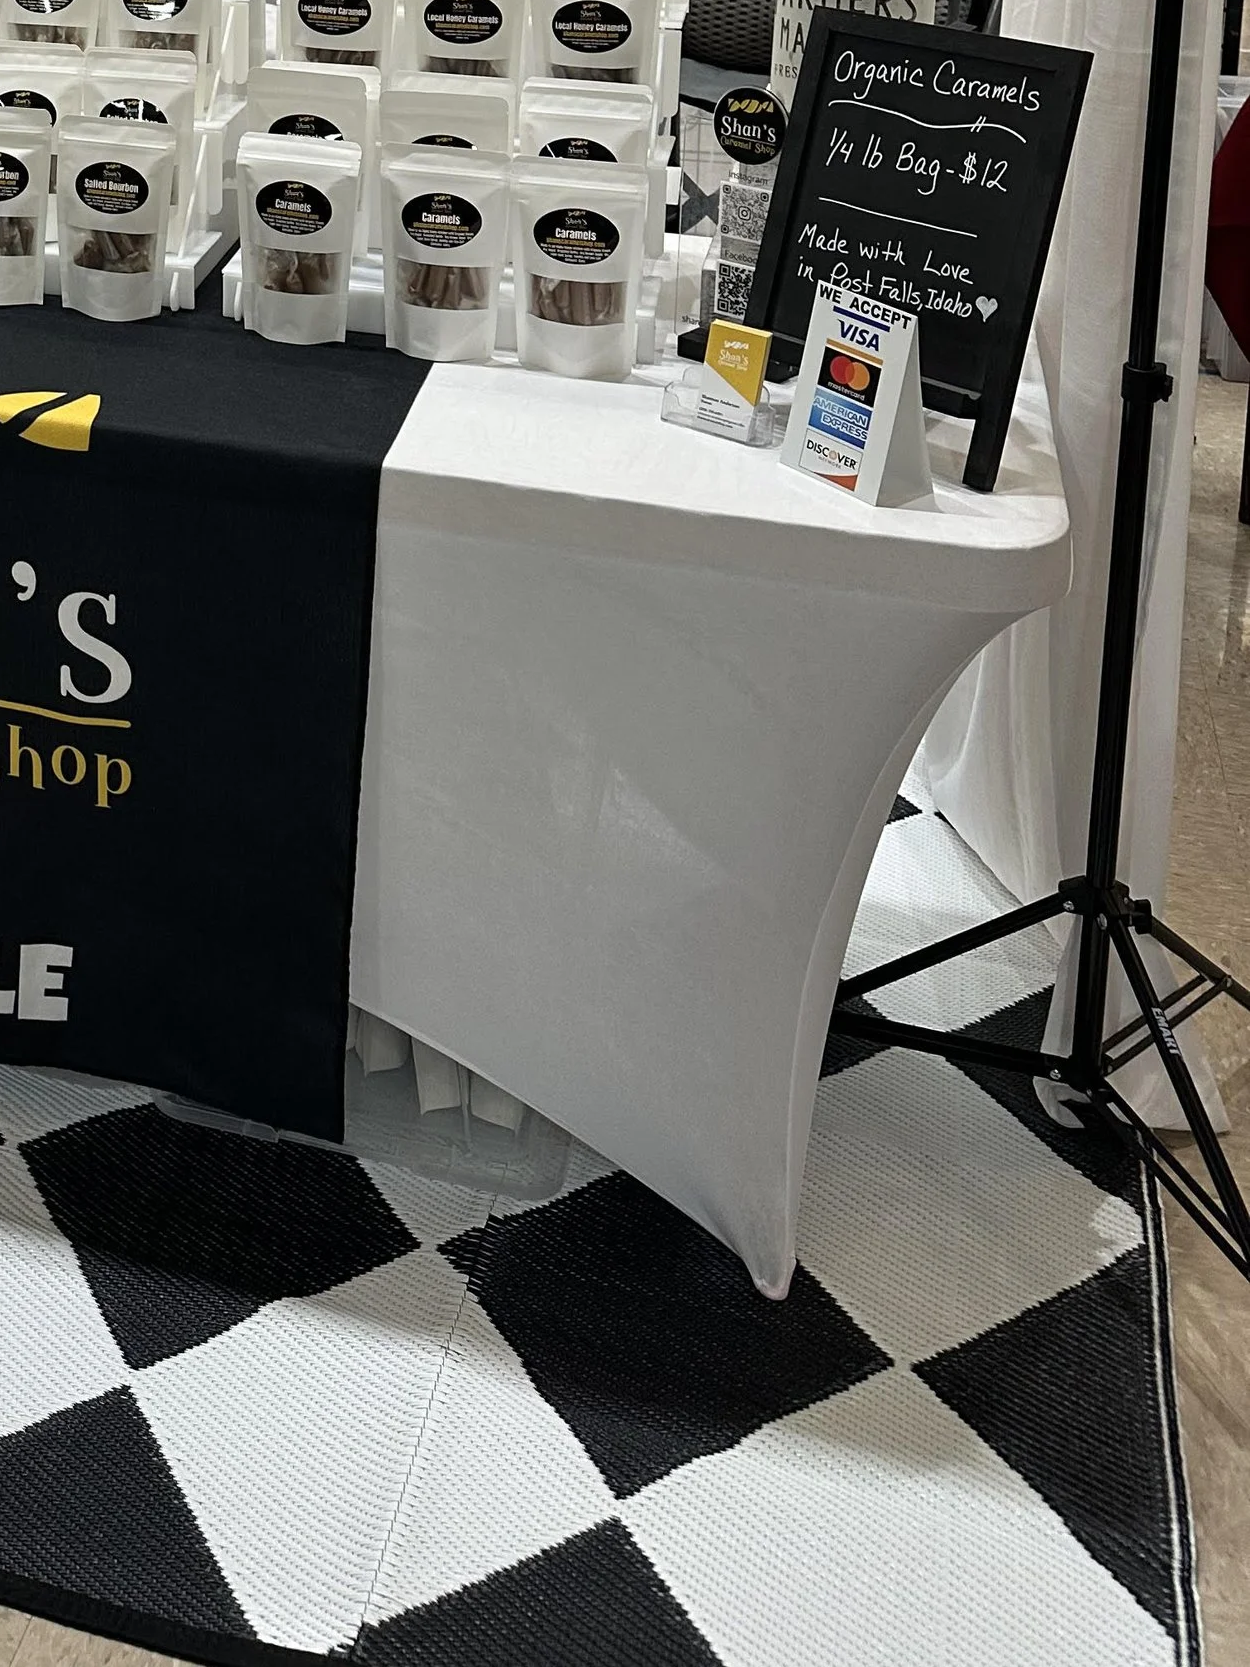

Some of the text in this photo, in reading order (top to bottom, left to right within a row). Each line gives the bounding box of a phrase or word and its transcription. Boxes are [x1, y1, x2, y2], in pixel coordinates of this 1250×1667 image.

[301, 4, 317, 14] Local
[338, 6, 367, 17] Caramels
[427, 13, 445, 23] Local
[467, 14, 498, 25] Caramels
[555, 21, 572, 31] Local
[595, 22, 628, 33] Caramels
[834, 50, 1040, 111] Organic Caramels
[720, 115, 777, 144] Shan's
[720, 135, 777, 158] Caramel Shop
[825, 127, 854, 167] 1/4
[862, 133, 884, 169] lb
[84, 178, 107, 189] Salted
[728, 170, 769, 186] Instagram
[275, 198, 311, 213] Caramels
[421, 211, 461, 225] Caramels
[555, 227, 598, 242] Caramels
[798, 223, 974, 285] Made with Love
[797, 255, 815, 283] in
[830, 262, 873, 295] Post
[818, 283, 912, 330] WE ACCEPT
[837, 318, 880, 352] VISA
[827, 380, 866, 402] mastercard
[813, 395, 868, 428] AMERICAN
[821, 413, 868, 441] EXPRESS
[806, 438, 858, 470] DISCOVER
